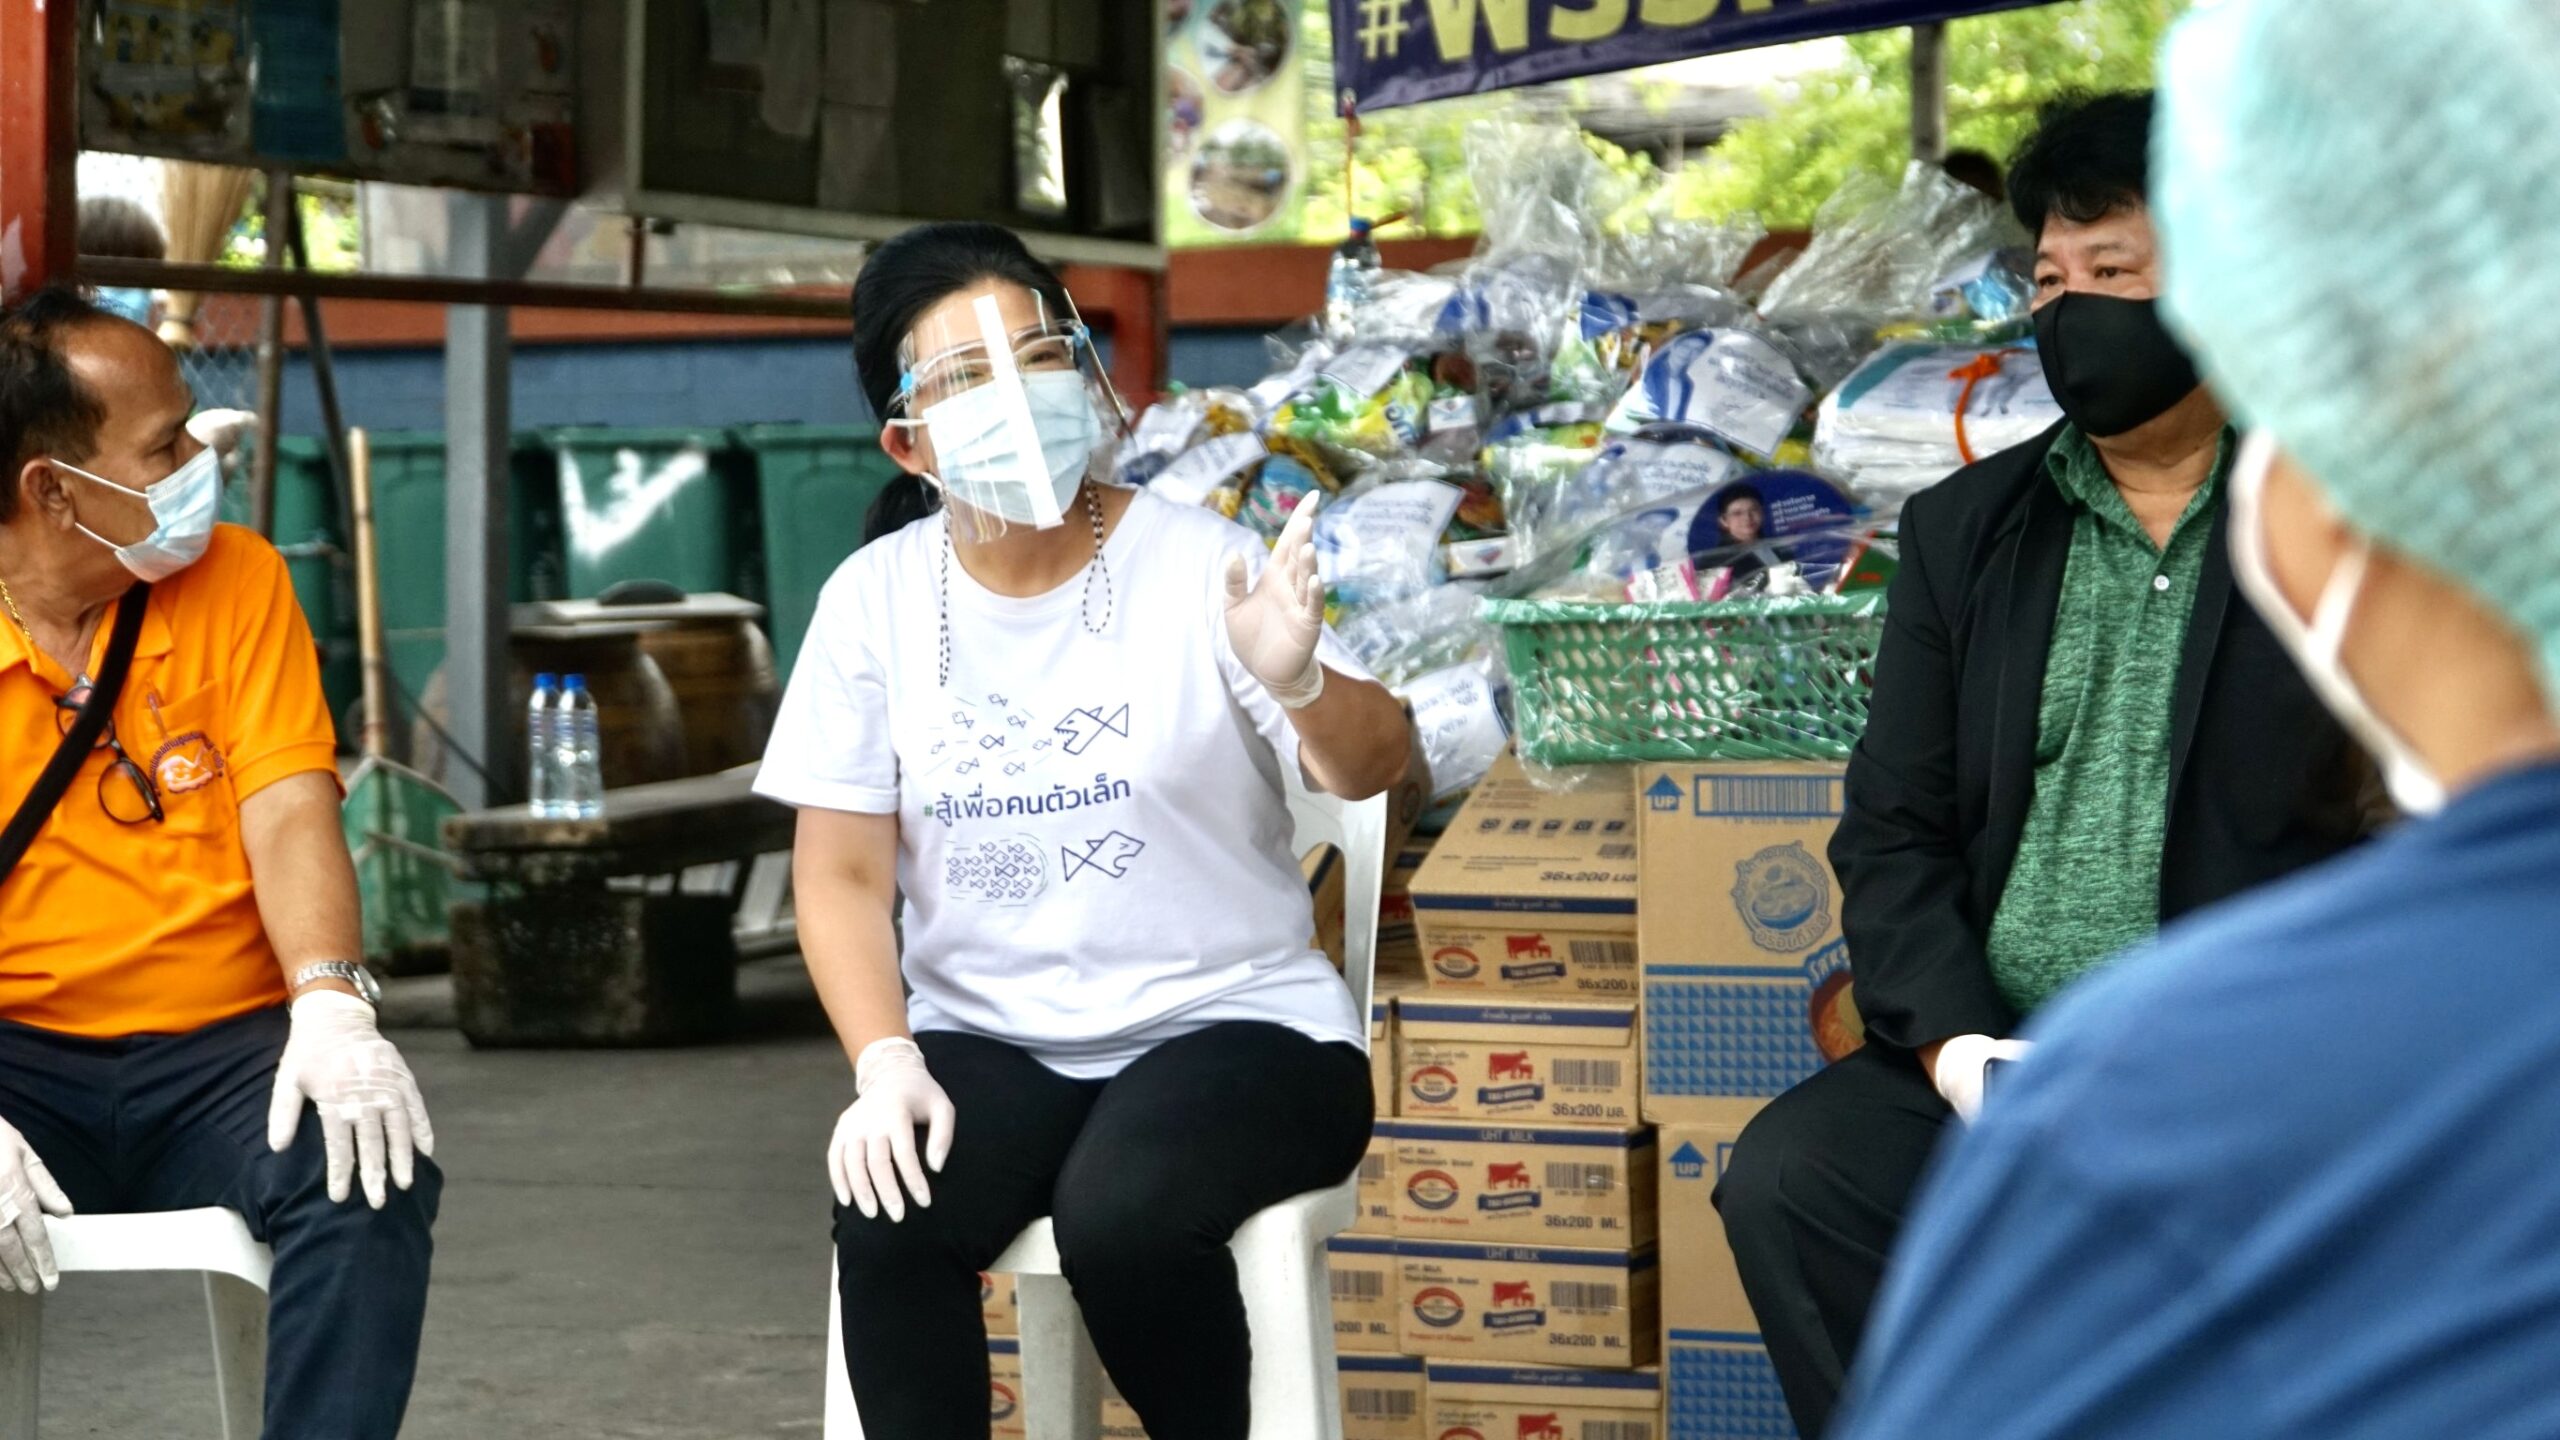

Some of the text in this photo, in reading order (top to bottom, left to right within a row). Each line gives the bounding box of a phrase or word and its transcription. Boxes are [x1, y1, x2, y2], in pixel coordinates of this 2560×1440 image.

[923, 772, 1131, 827] #สู้เพื่อคนตัวเล็ก
[1653, 796, 1676, 808] UP
[1552, 1103, 1603, 1117] 36x200
[1481, 1128, 1536, 1142] UHT MILK
[1677, 1162, 1700, 1176] UP
[1544, 1214, 1594, 1229] 36x200
[1486, 1246, 1540, 1261] UHT MILK
[1549, 1332, 1597, 1347] 36x200
